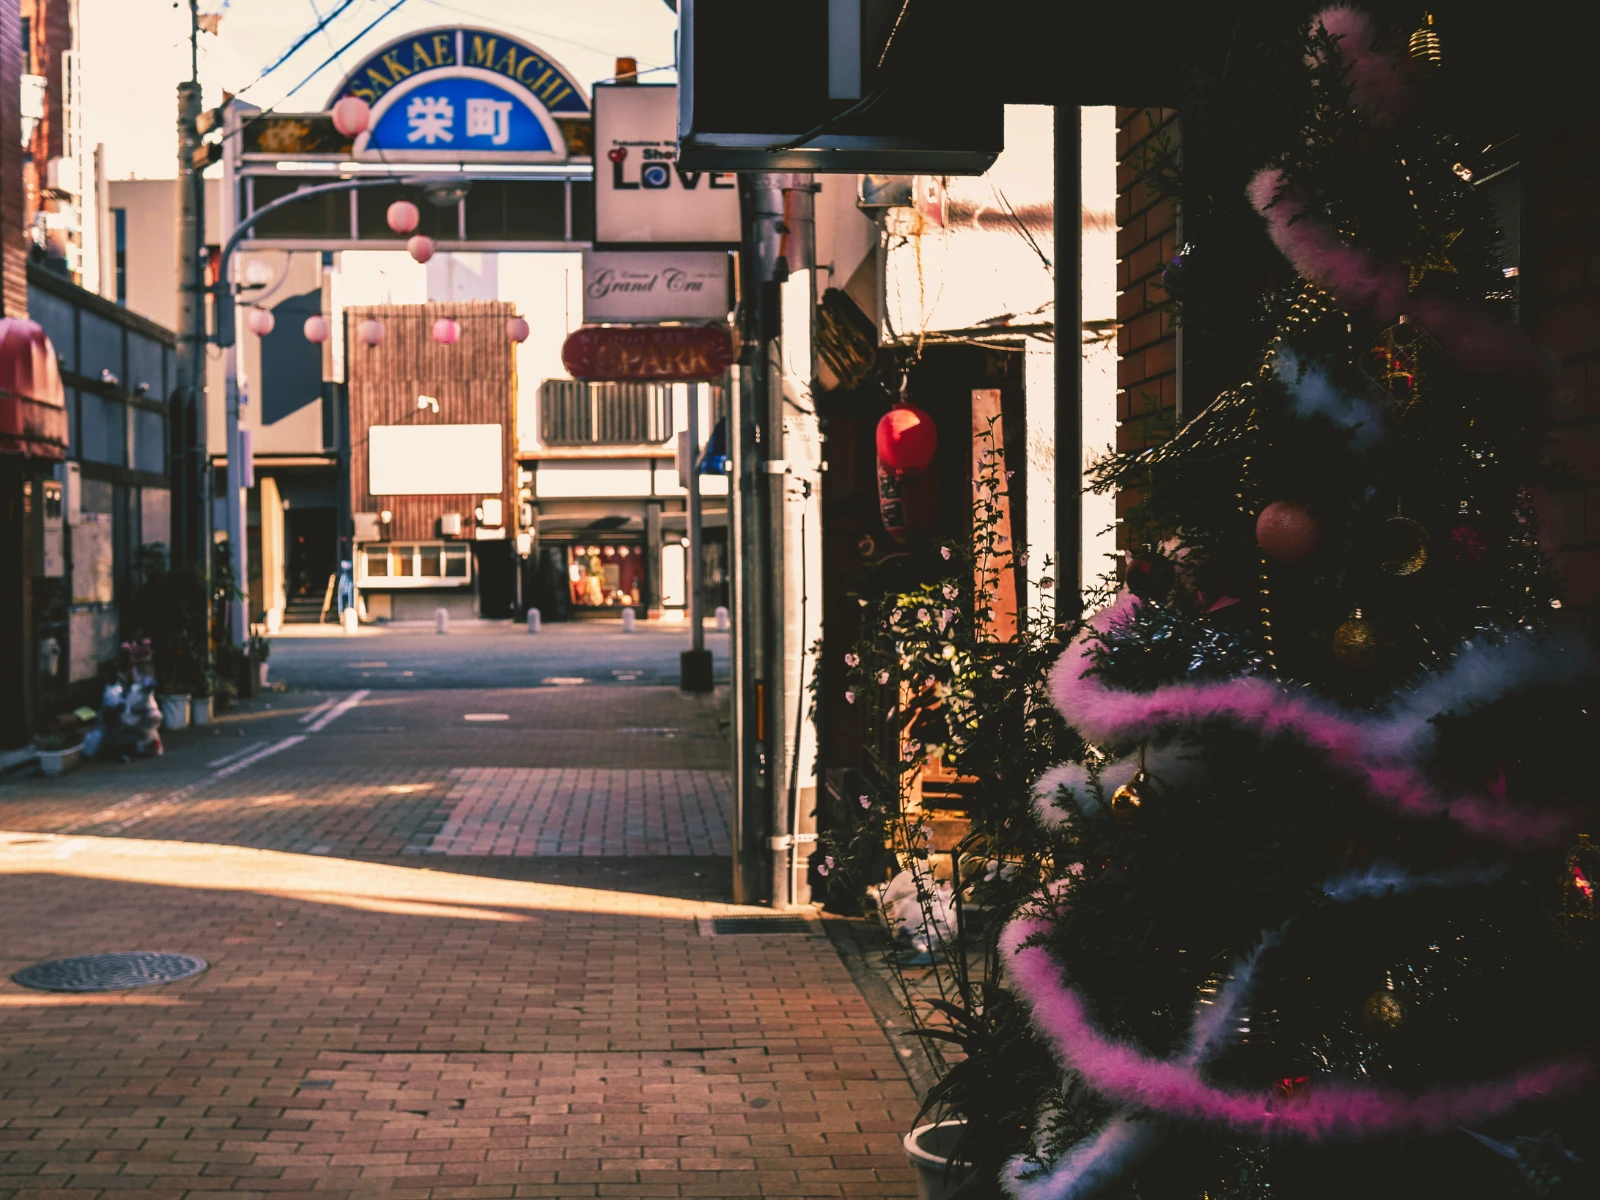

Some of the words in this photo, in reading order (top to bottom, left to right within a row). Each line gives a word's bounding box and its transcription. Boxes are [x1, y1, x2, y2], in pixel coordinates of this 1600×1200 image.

[350, 35, 454, 101] SAKAE
[469, 35, 572, 107] MACHI
[407, 96, 512, 145] 栄町
[613, 162, 735, 190] LOVE
[587, 267, 659, 299] Grand
[661, 267, 704, 293] Cru
